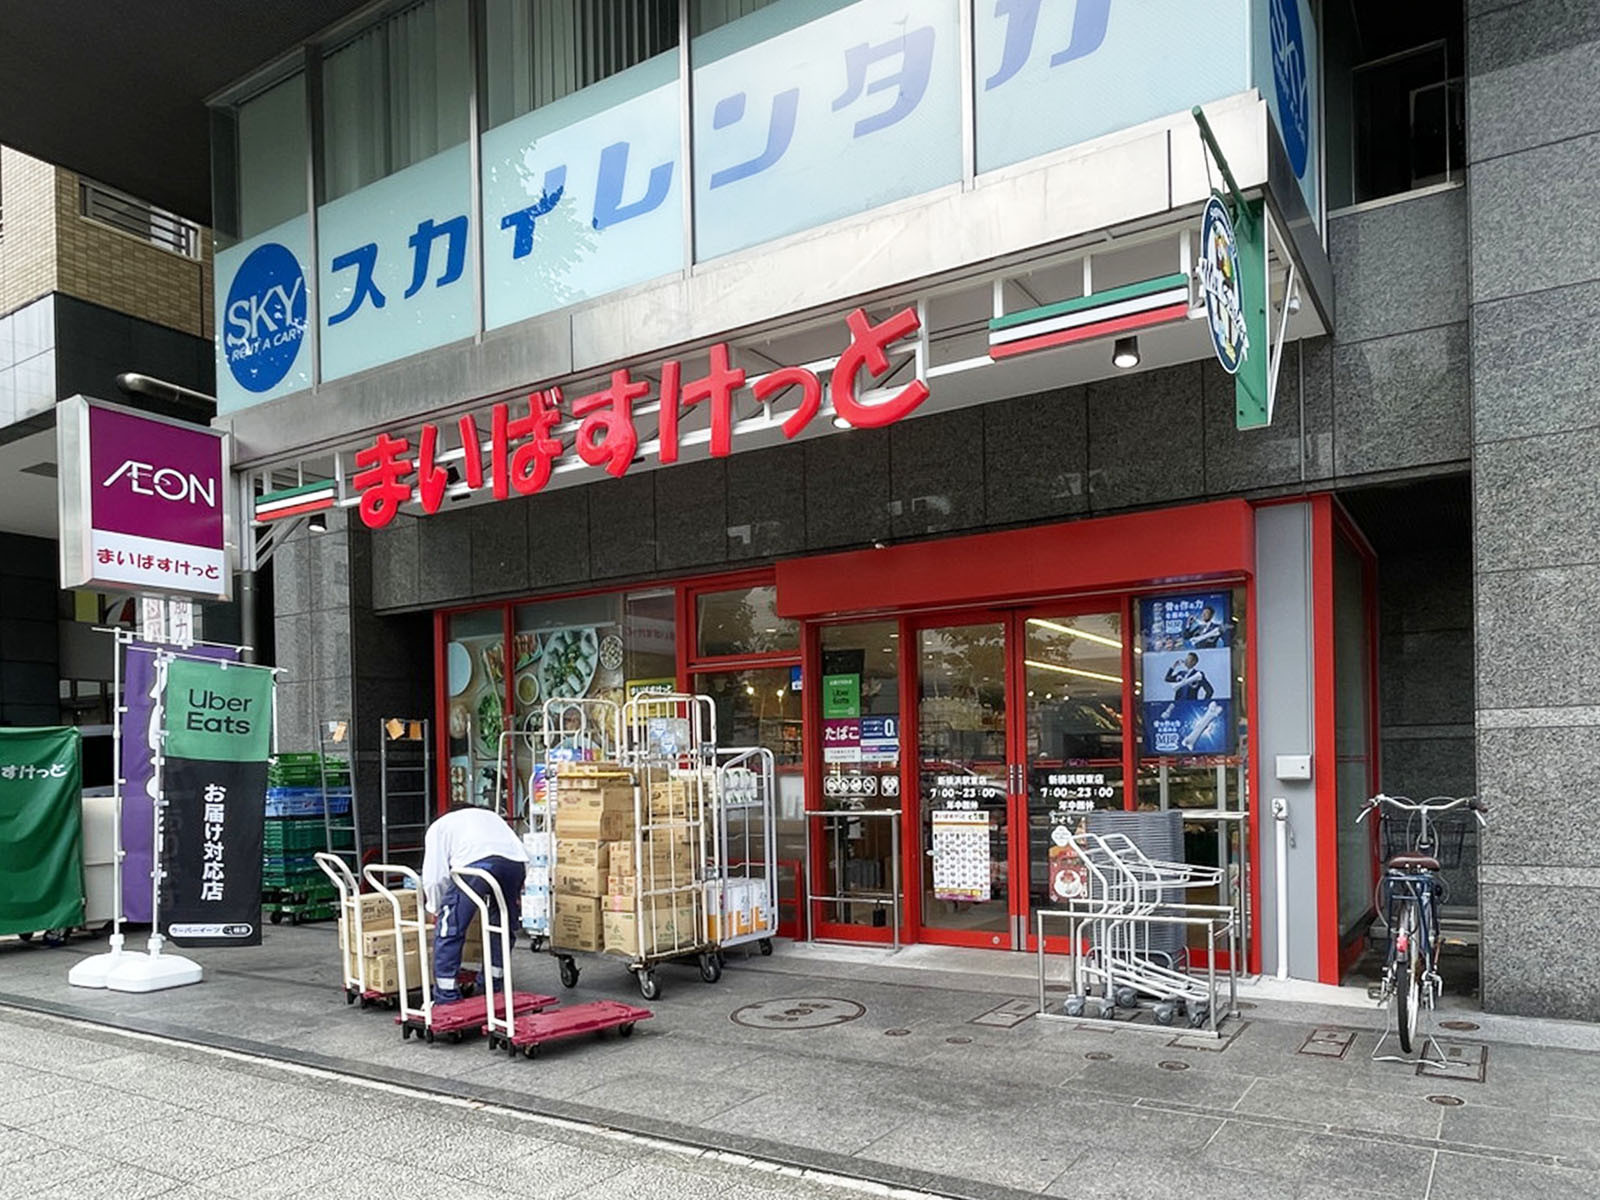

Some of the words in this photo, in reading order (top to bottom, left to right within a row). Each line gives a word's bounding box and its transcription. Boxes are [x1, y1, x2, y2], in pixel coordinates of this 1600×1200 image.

[226, 276, 303, 348] SKY
[351, 306, 930, 528] まいばすけっと
[96, 548, 220, 580] まいばすけっと
[189, 688, 253, 713] Uber
[186, 711, 251, 735] Eats
[825, 726, 860, 741] たばこ
[1, 764, 68, 780] すけっと
[200, 783, 227, 902] お届け対応店
